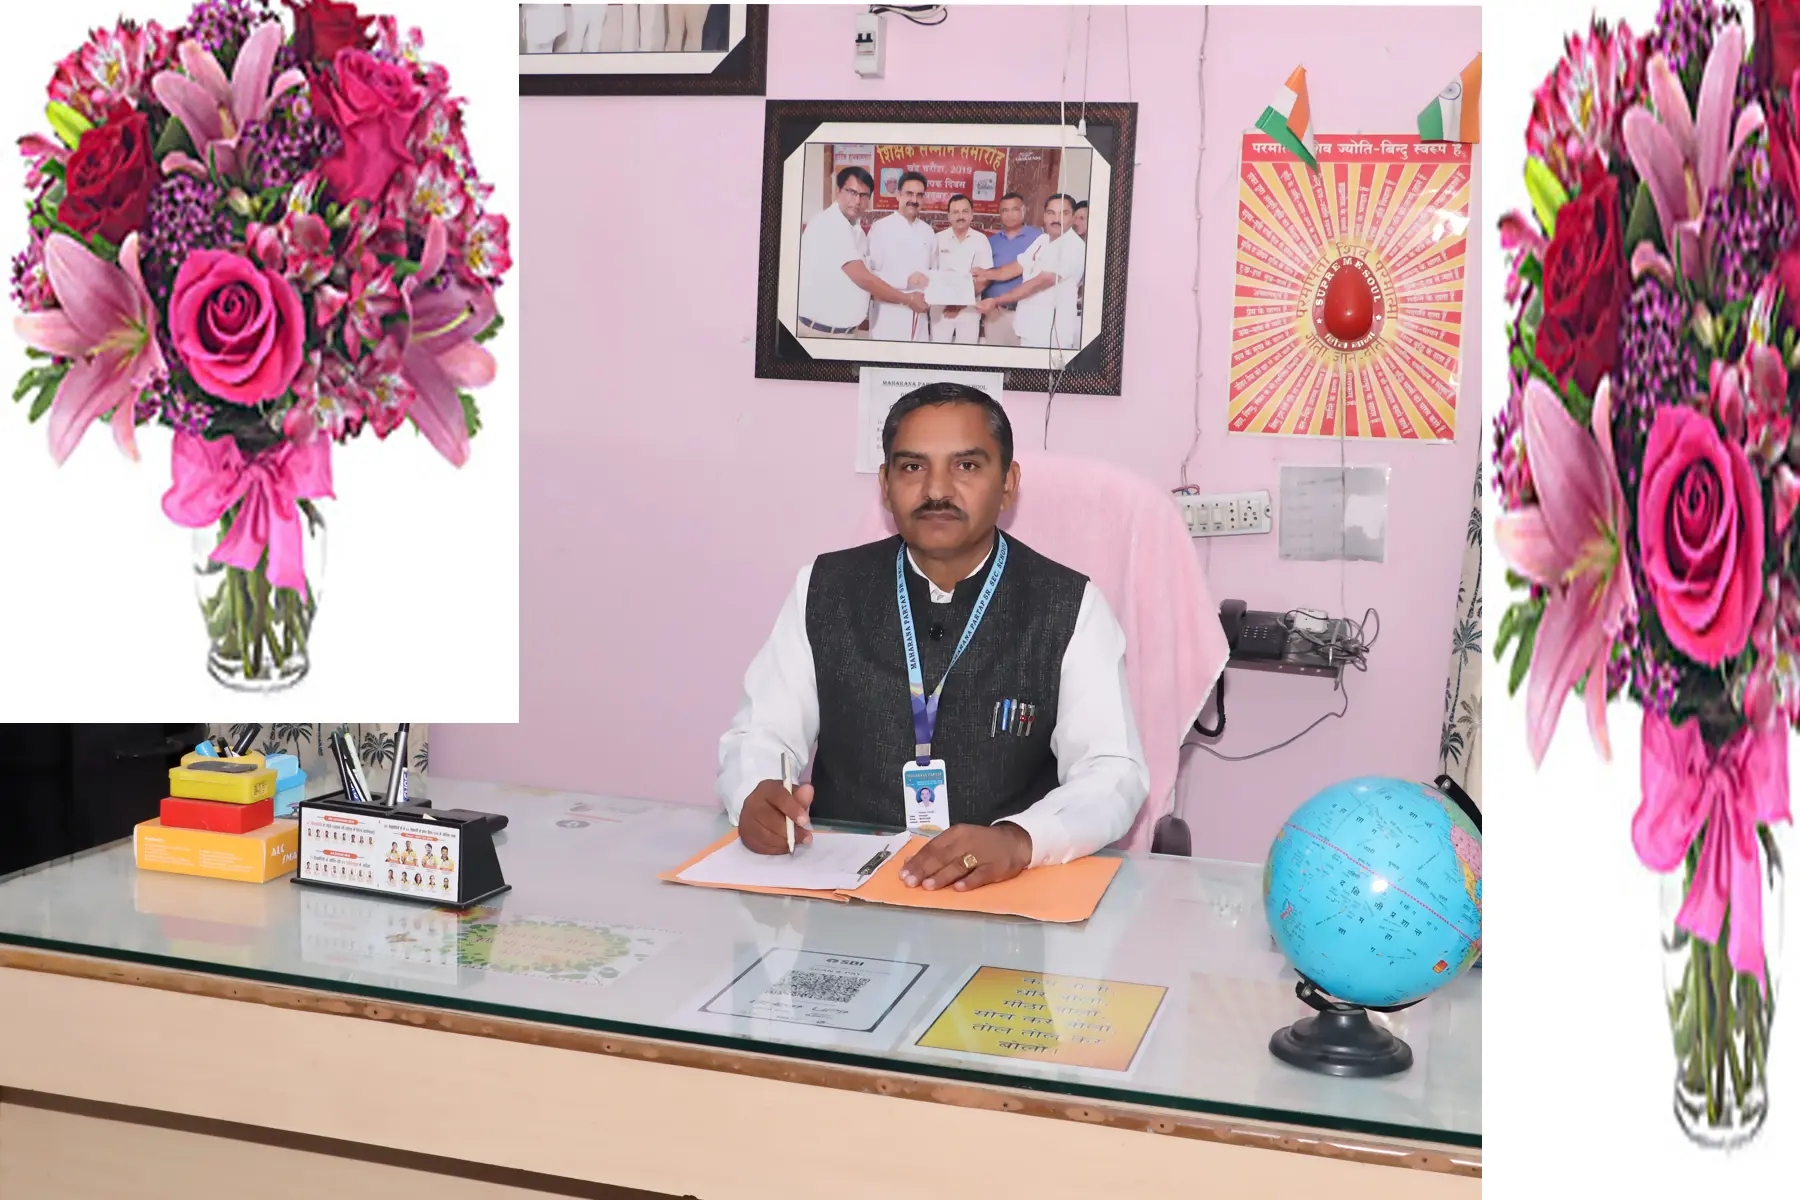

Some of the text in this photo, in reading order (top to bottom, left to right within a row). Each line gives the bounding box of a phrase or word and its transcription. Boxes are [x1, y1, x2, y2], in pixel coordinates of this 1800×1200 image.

[877, 145, 914, 165] शिक्षक
[960, 146, 1005, 171] समारोह
[1413, 143, 1447, 155] स्वरूप
[950, 165, 973, 175] 2019
[944, 177, 966, 189] दिवस
[1361, 269, 1382, 303] SOUL
[899, 594, 911, 625] PARTAP
[970, 600, 985, 630] PARTAP
[904, 625, 917, 670] MAHARANA
[1002, 998, 1048, 1012] मीठा
[1023, 1014, 1053, 1025] कर
